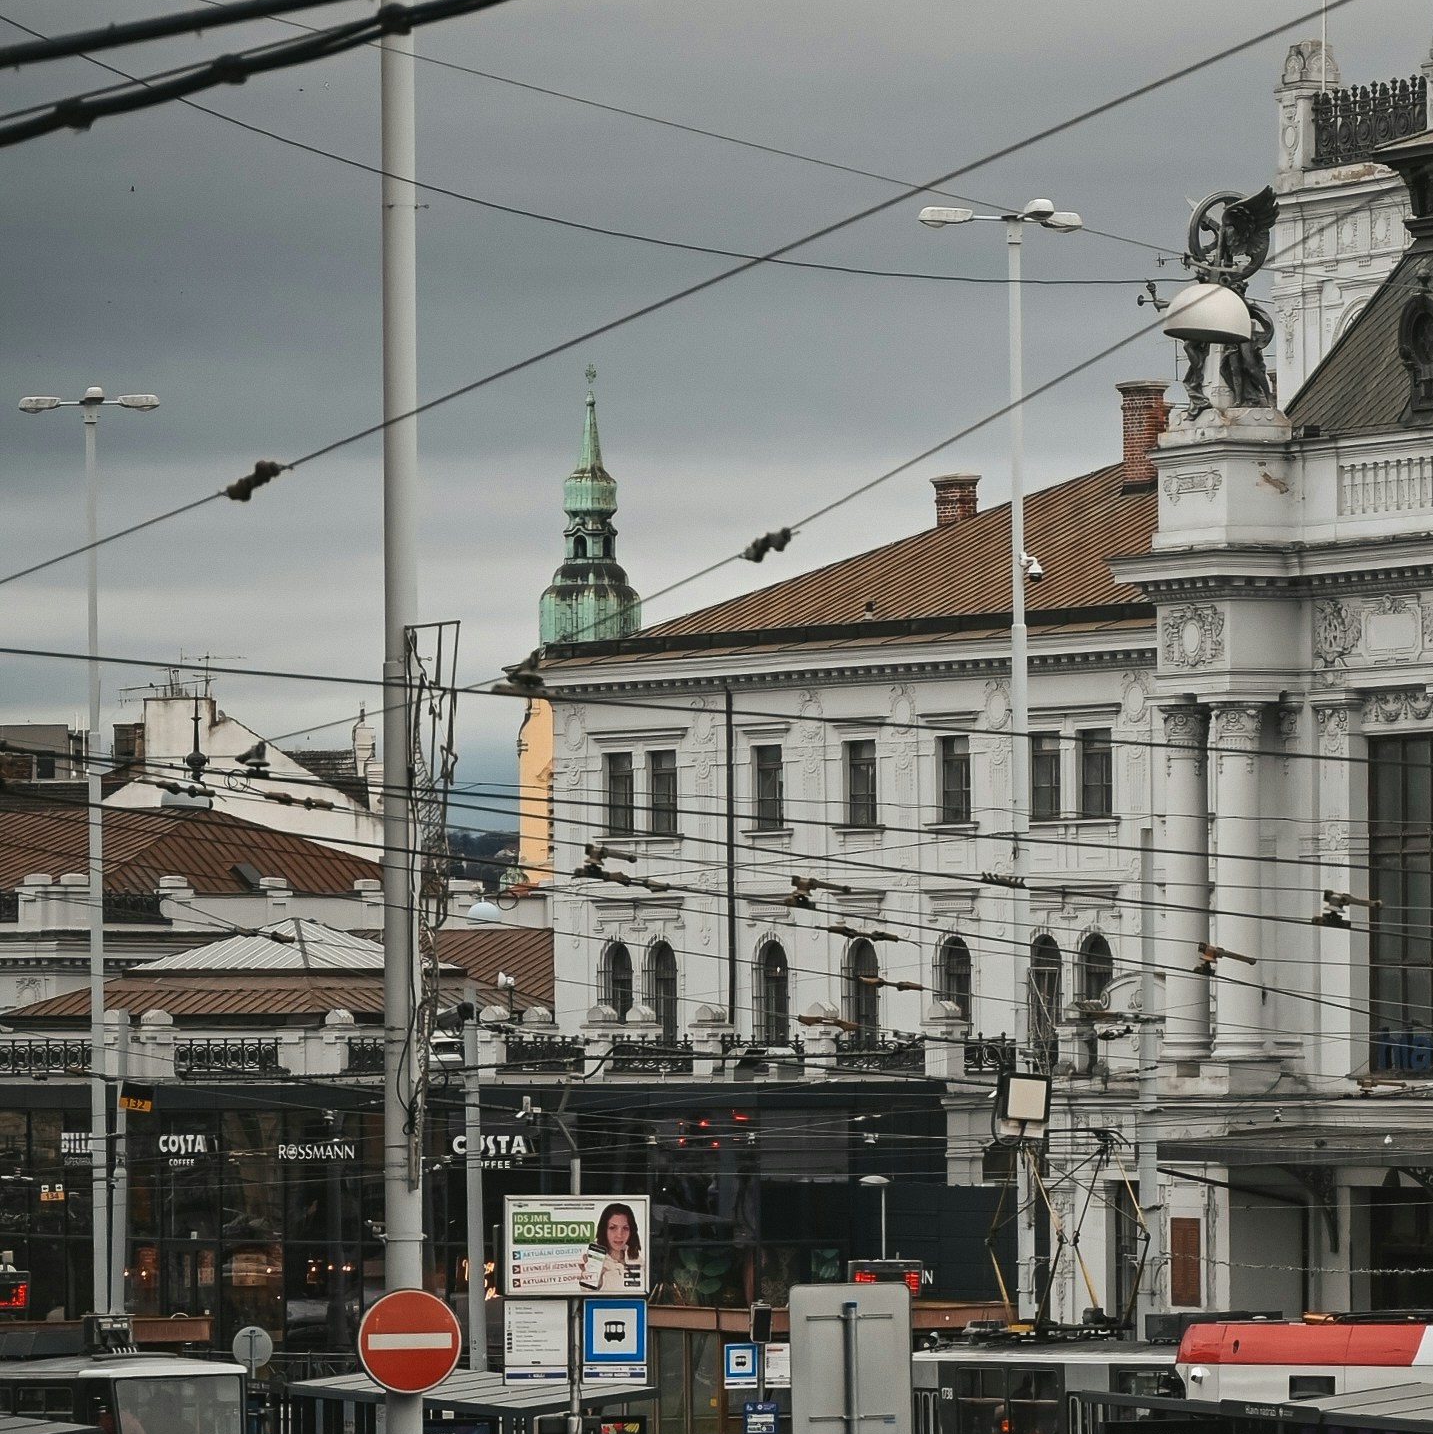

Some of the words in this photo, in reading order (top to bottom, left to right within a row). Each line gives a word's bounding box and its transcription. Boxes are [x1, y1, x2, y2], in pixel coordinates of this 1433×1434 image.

[126, 1097, 144, 1110] 132
[159, 1134, 206, 1155] COSTA
[278, 1144, 355, 1160] ROSSMANN
[168, 1158, 195, 1166] COFFEE
[514, 1214, 529, 1223] IDS
[530, 1214, 549, 1223] JMK
[514, 1224, 591, 1238] POSEIDON
